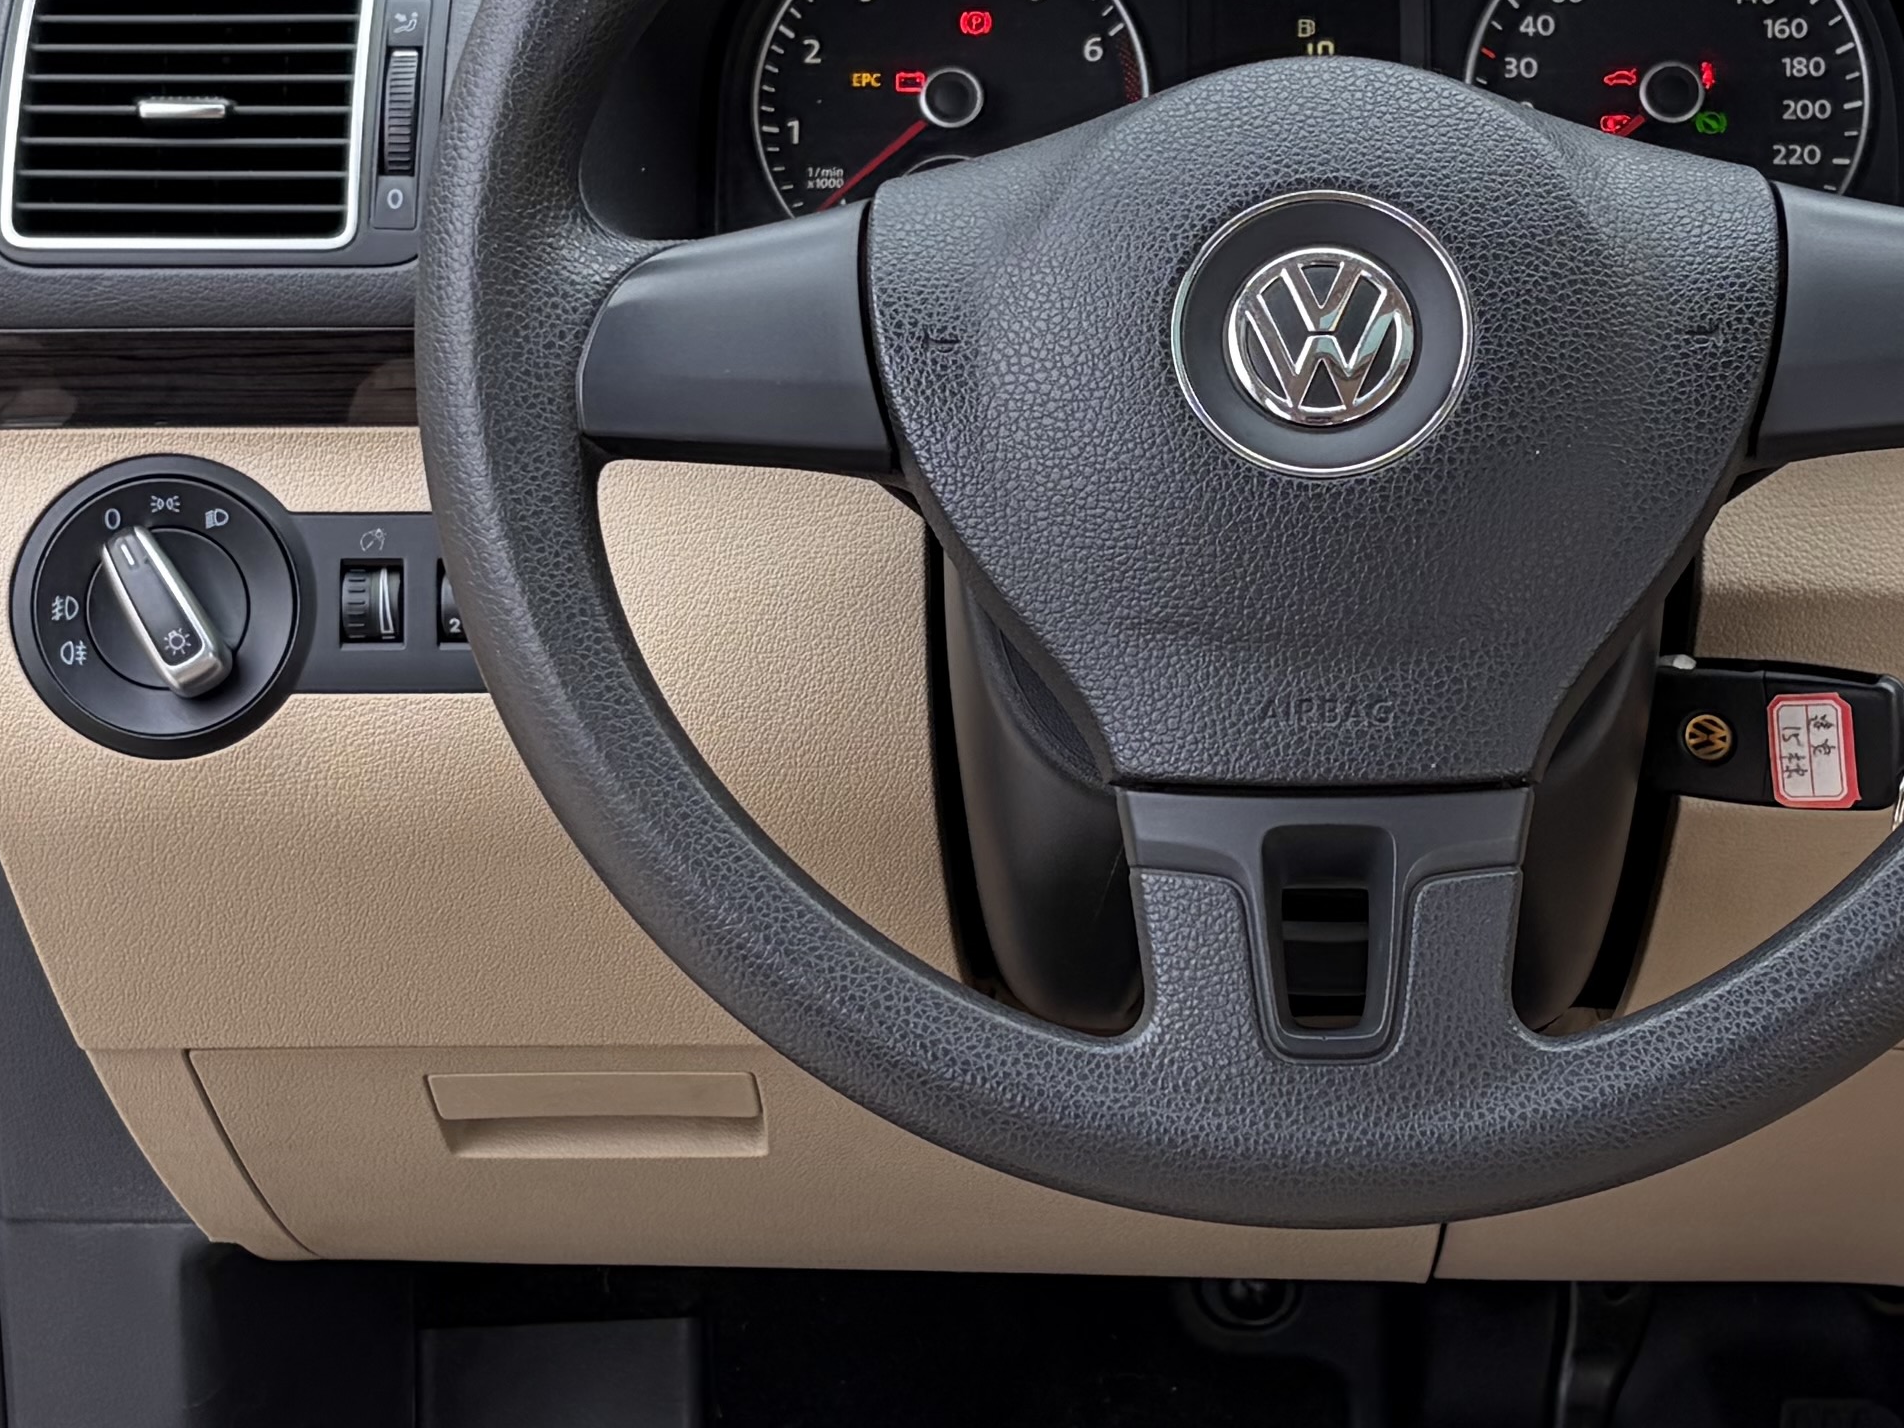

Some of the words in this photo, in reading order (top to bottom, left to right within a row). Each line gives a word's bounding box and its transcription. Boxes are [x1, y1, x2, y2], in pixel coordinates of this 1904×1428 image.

[1518, 14, 1556, 37] 40
[1764, 17, 1809, 40] 160
[802, 39, 822, 65] 2
[1082, 37, 1104, 63] 6
[1503, 57, 1539, 79] 30
[1781, 56, 1826, 79] 180
[851, 73, 882, 88] EPC
[1781, 98, 1832, 121] 200
[786, 119, 801, 145] 1
[1772, 144, 1822, 166] 220
[449, 617, 462, 633] 2
